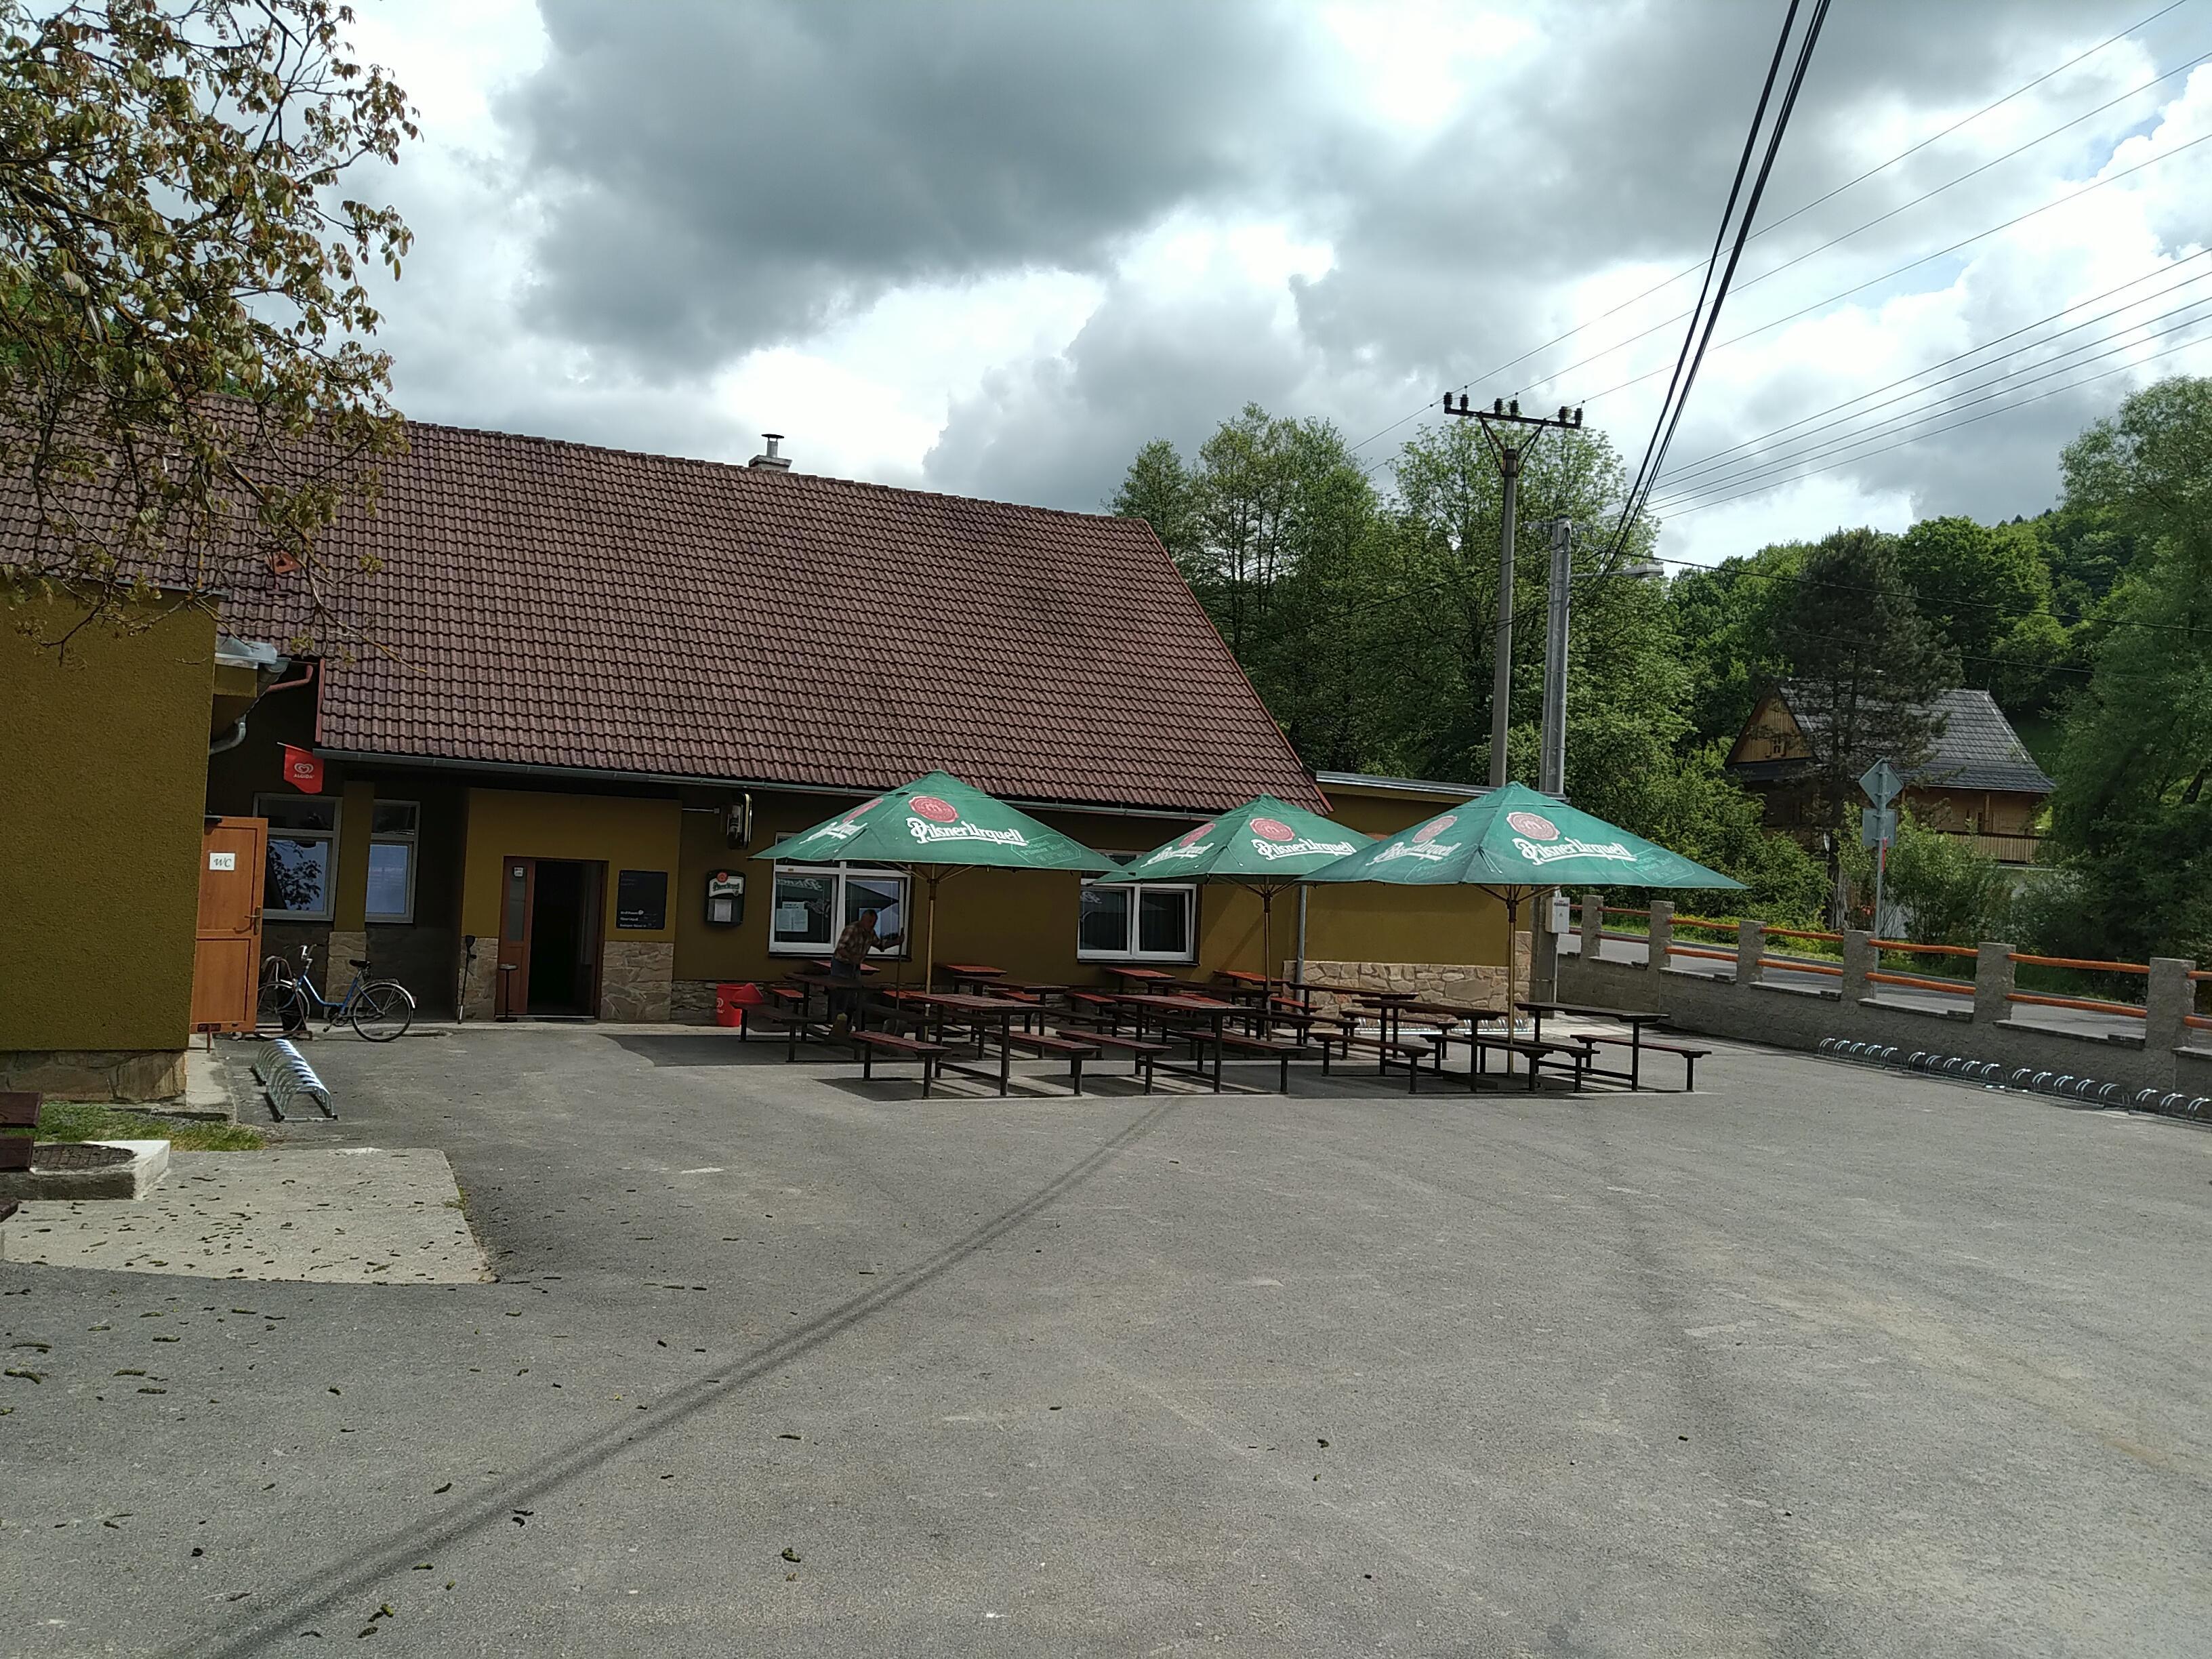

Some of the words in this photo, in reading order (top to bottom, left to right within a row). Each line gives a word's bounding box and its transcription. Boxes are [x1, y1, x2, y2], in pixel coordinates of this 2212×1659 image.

[905, 817, 968, 844] Pilsner
[960, 821, 1028, 846] Urquell
[213, 857, 232, 867] WC
[1250, 839, 1305, 861] Pilsner
[1298, 838, 1357, 857] Urquell
[1512, 838, 1576, 865] Pilsner
[1564, 836, 1636, 861] Urquell
